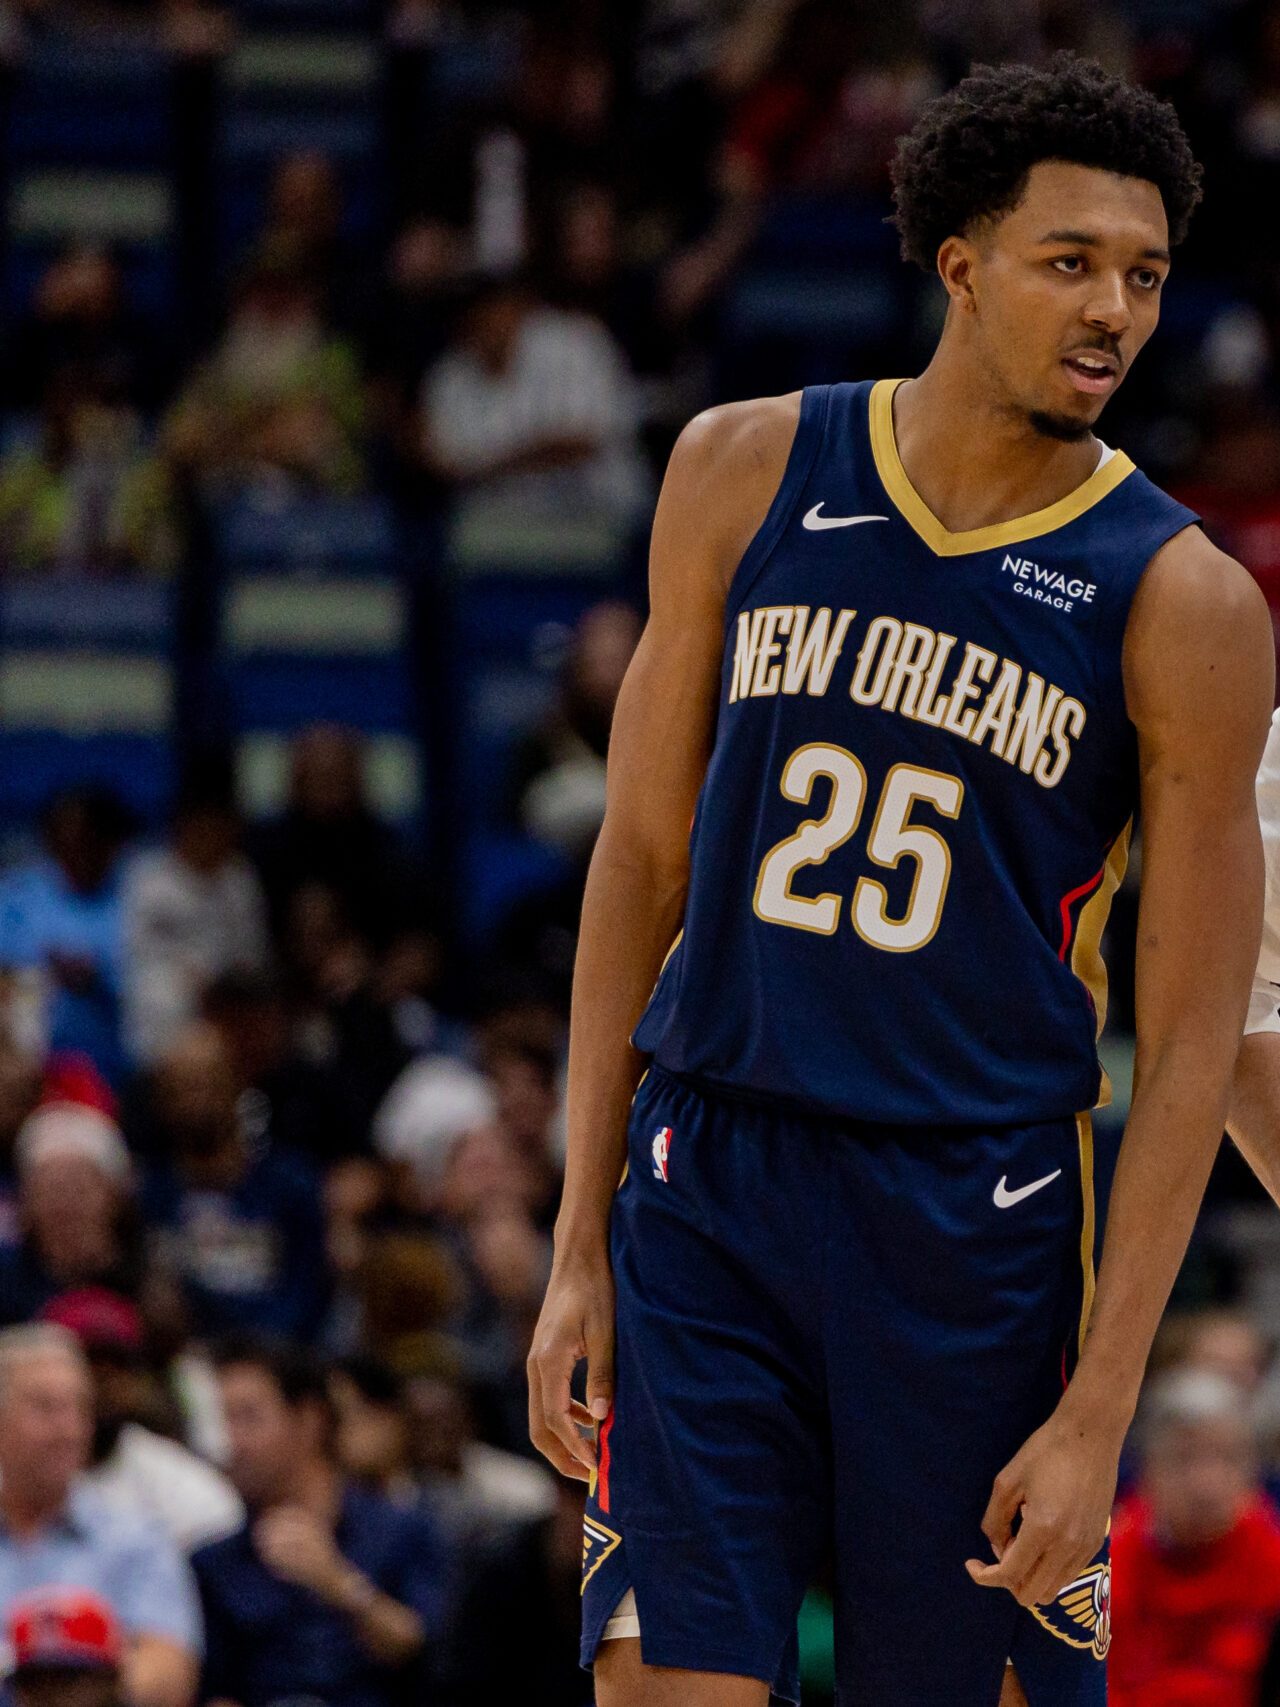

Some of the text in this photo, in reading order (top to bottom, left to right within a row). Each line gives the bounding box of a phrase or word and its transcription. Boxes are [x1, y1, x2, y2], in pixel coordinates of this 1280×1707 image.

[1001, 553, 1097, 603] NEWAGE
[1013, 582, 1074, 613] GARAGE
[729, 605, 1087, 788] NEW ORLEANS
[753, 742, 964, 953] 25
